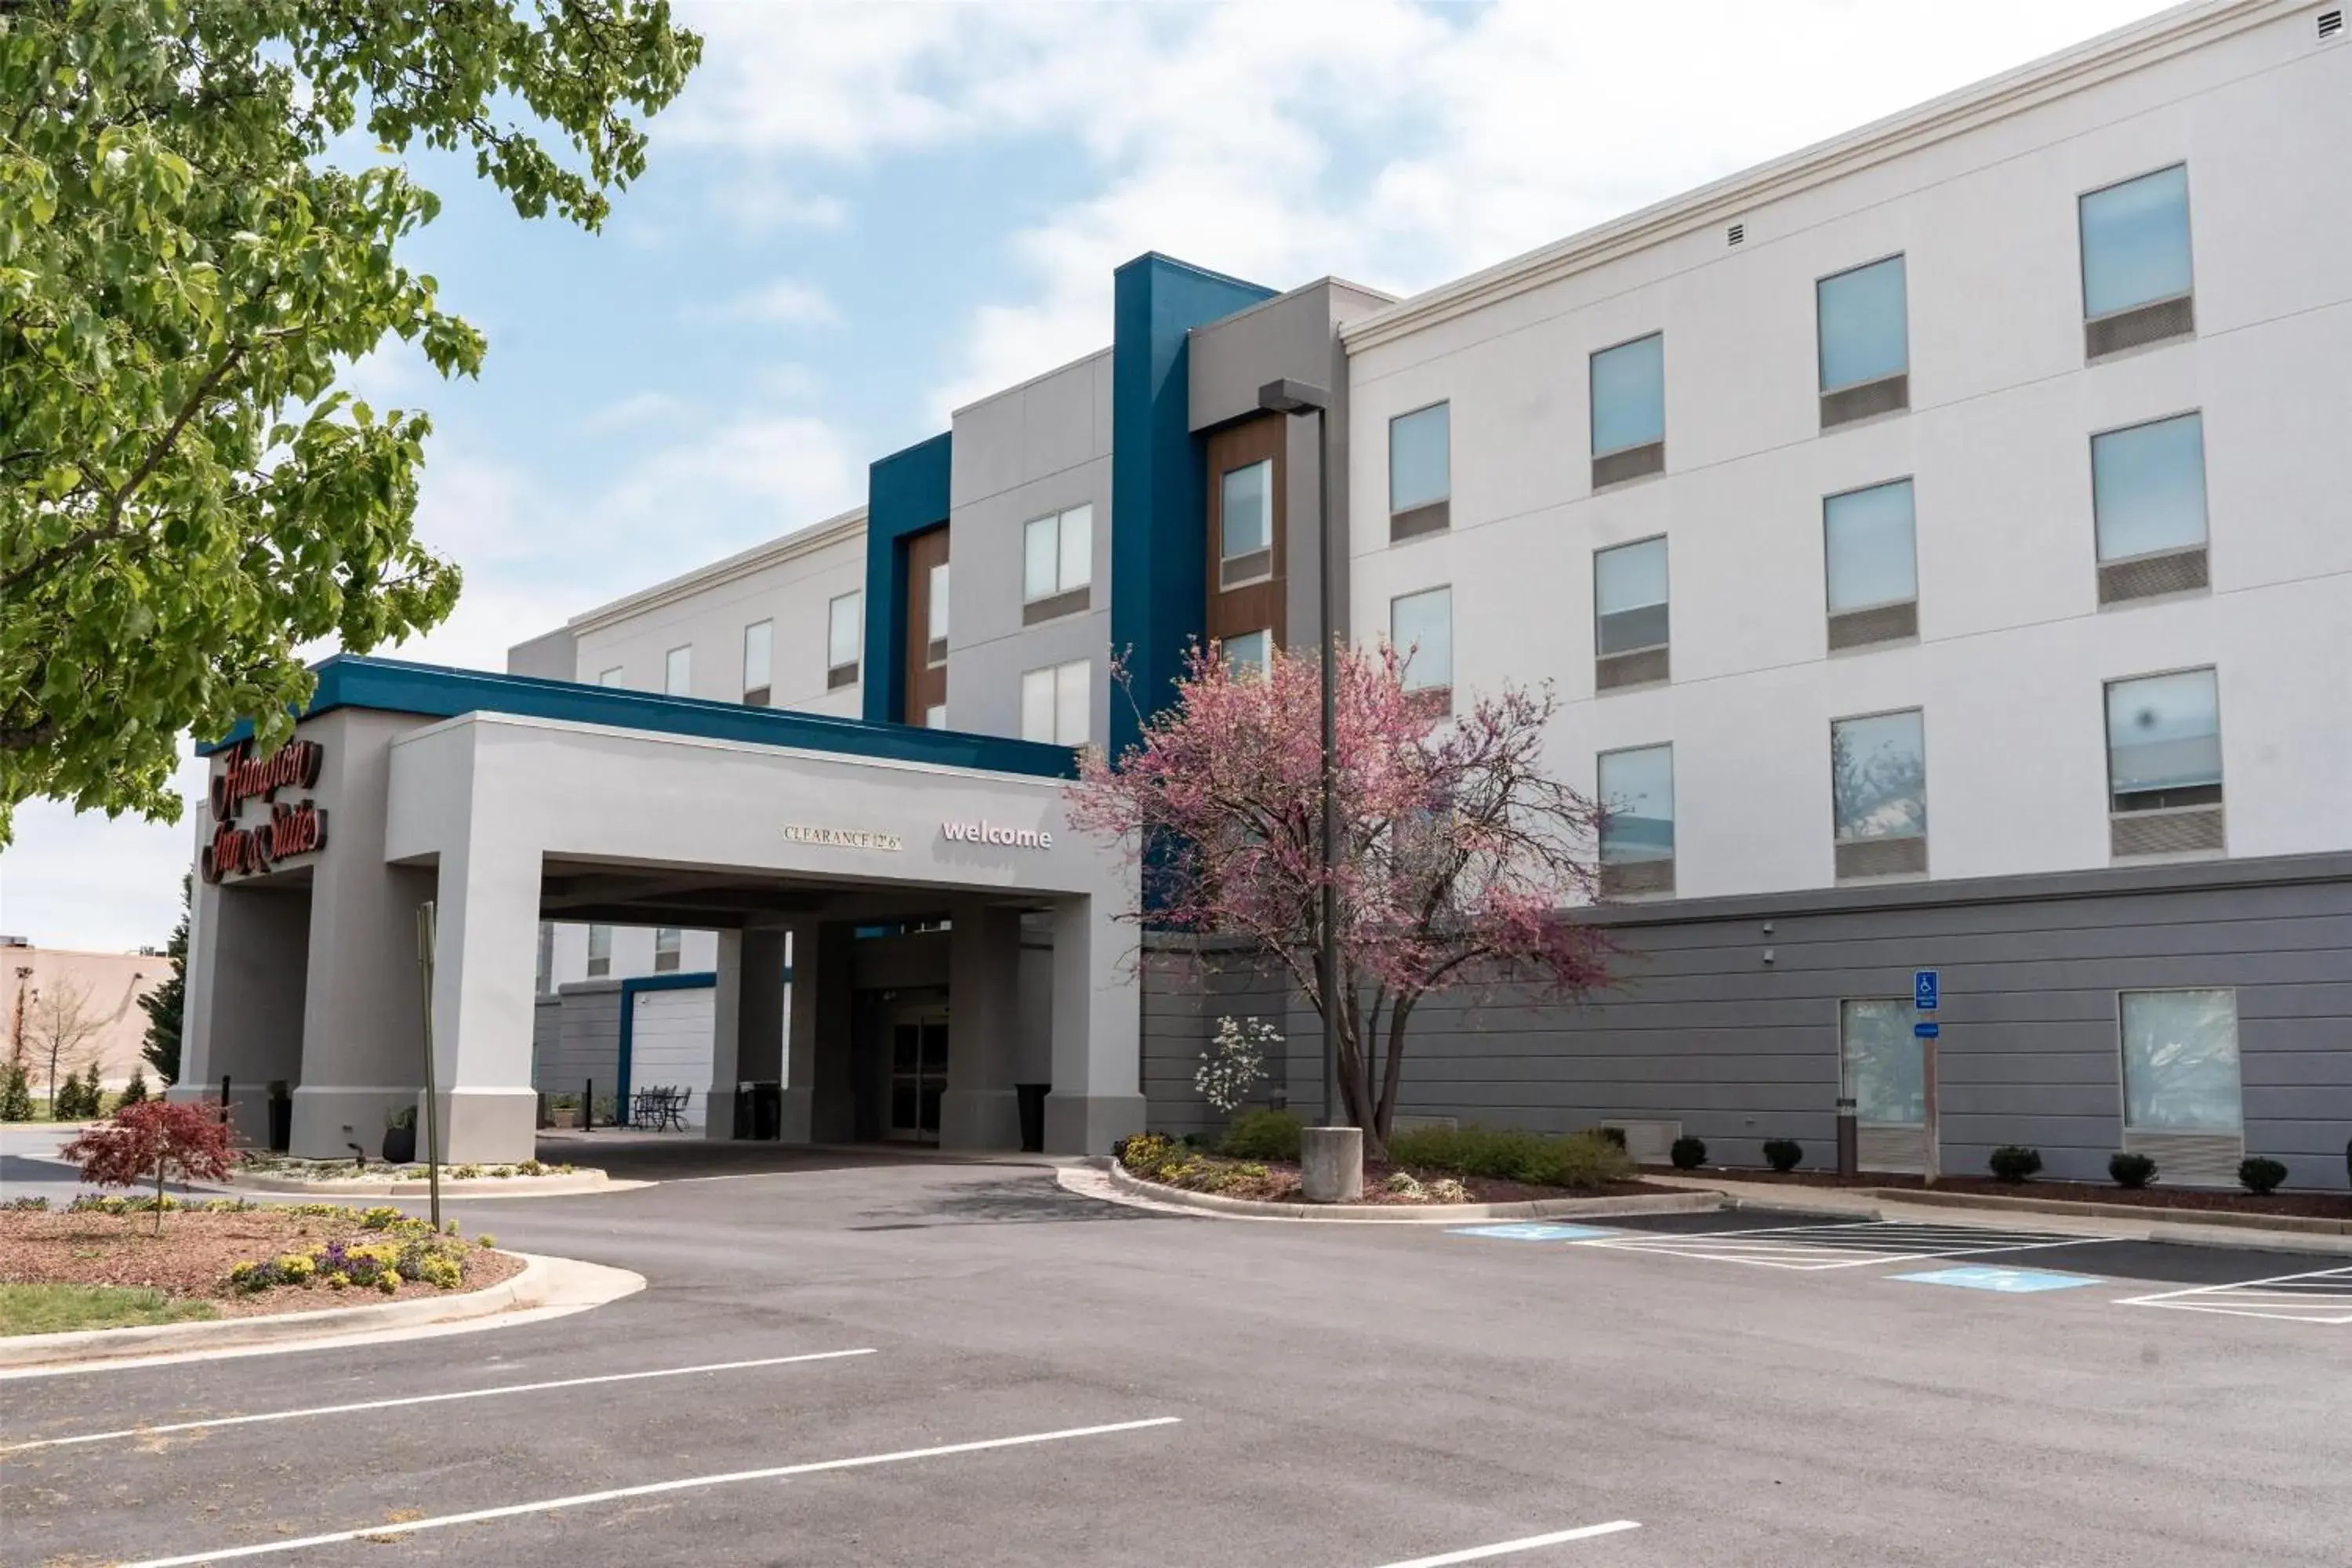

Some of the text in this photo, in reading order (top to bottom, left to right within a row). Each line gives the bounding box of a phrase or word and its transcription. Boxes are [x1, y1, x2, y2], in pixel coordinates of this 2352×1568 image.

[261, 801, 328, 862] Suites
[784, 826, 869, 847] CLEARANCE
[942, 819, 1053, 850] welcome
